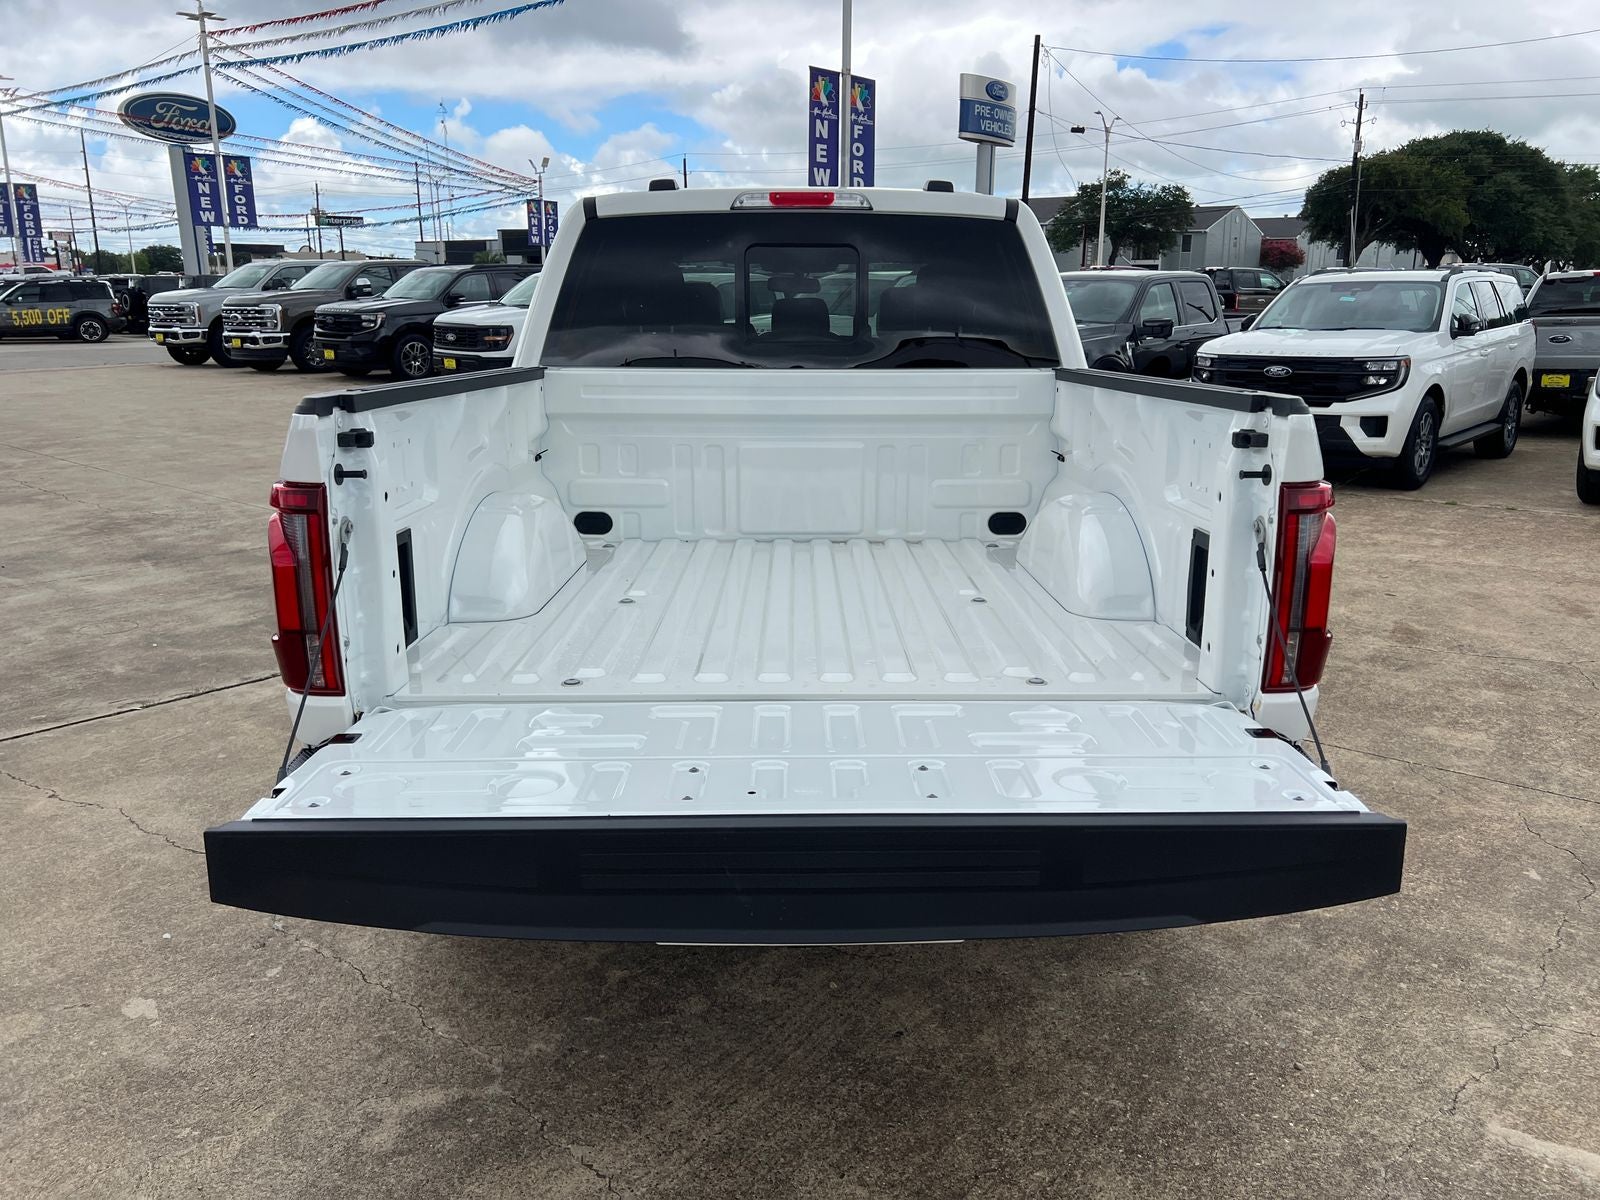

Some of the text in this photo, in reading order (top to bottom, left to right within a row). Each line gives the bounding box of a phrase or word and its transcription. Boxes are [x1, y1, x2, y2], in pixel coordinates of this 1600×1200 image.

[150, 101, 212, 133] Ford
[980, 119, 1013, 136] VEHICLES
[813, 119, 831, 186] NEW
[852, 125, 865, 187] FORD
[197, 182, 215, 223] NEW
[234, 184, 249, 225] FORD
[24, 204, 36, 236] FORD
[531, 217, 540, 244] NEW
[47, 309, 70, 324] OFF
